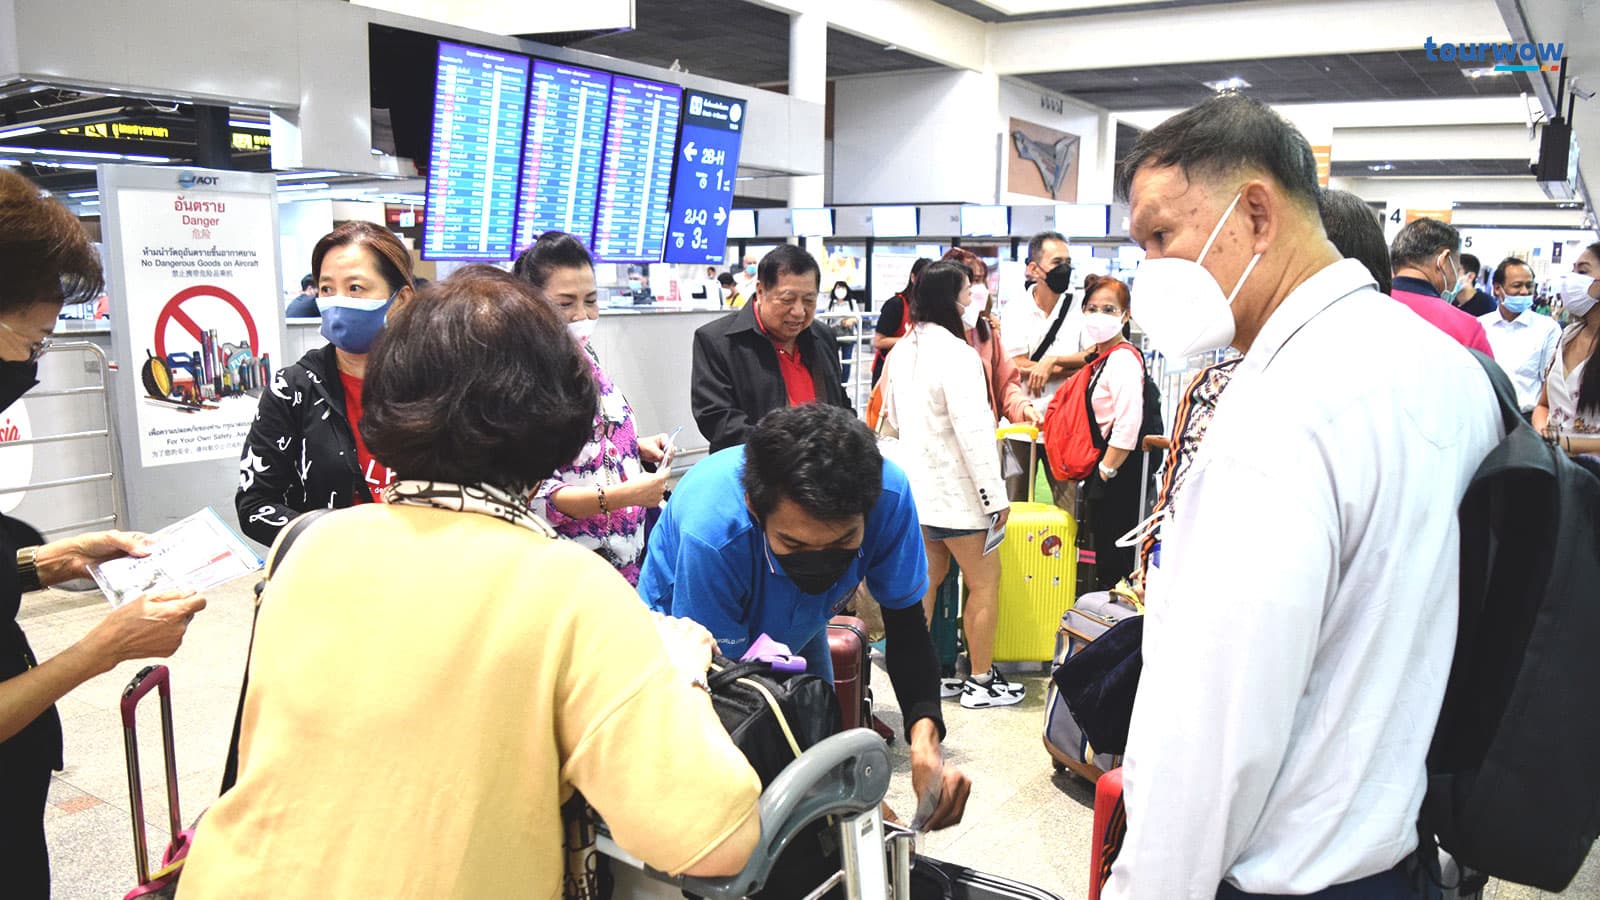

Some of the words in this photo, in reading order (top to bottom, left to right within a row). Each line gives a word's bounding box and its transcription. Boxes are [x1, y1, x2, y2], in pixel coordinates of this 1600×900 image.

[701, 148, 725, 166] 2B-H
[196, 176, 219, 186] AOT
[174, 195, 225, 213] อันตราย
[182, 215, 220, 228] Danger
[684, 208, 707, 225] 2J-Q
[1390, 208, 1401, 224] 4
[691, 227, 702, 249] 3
[1464, 237, 1473, 248] 5
[141, 259, 152, 267] No
[155, 259, 195, 268] Dangerous
[197, 259, 221, 267] Goods
[234, 260, 259, 268] Aircraft
